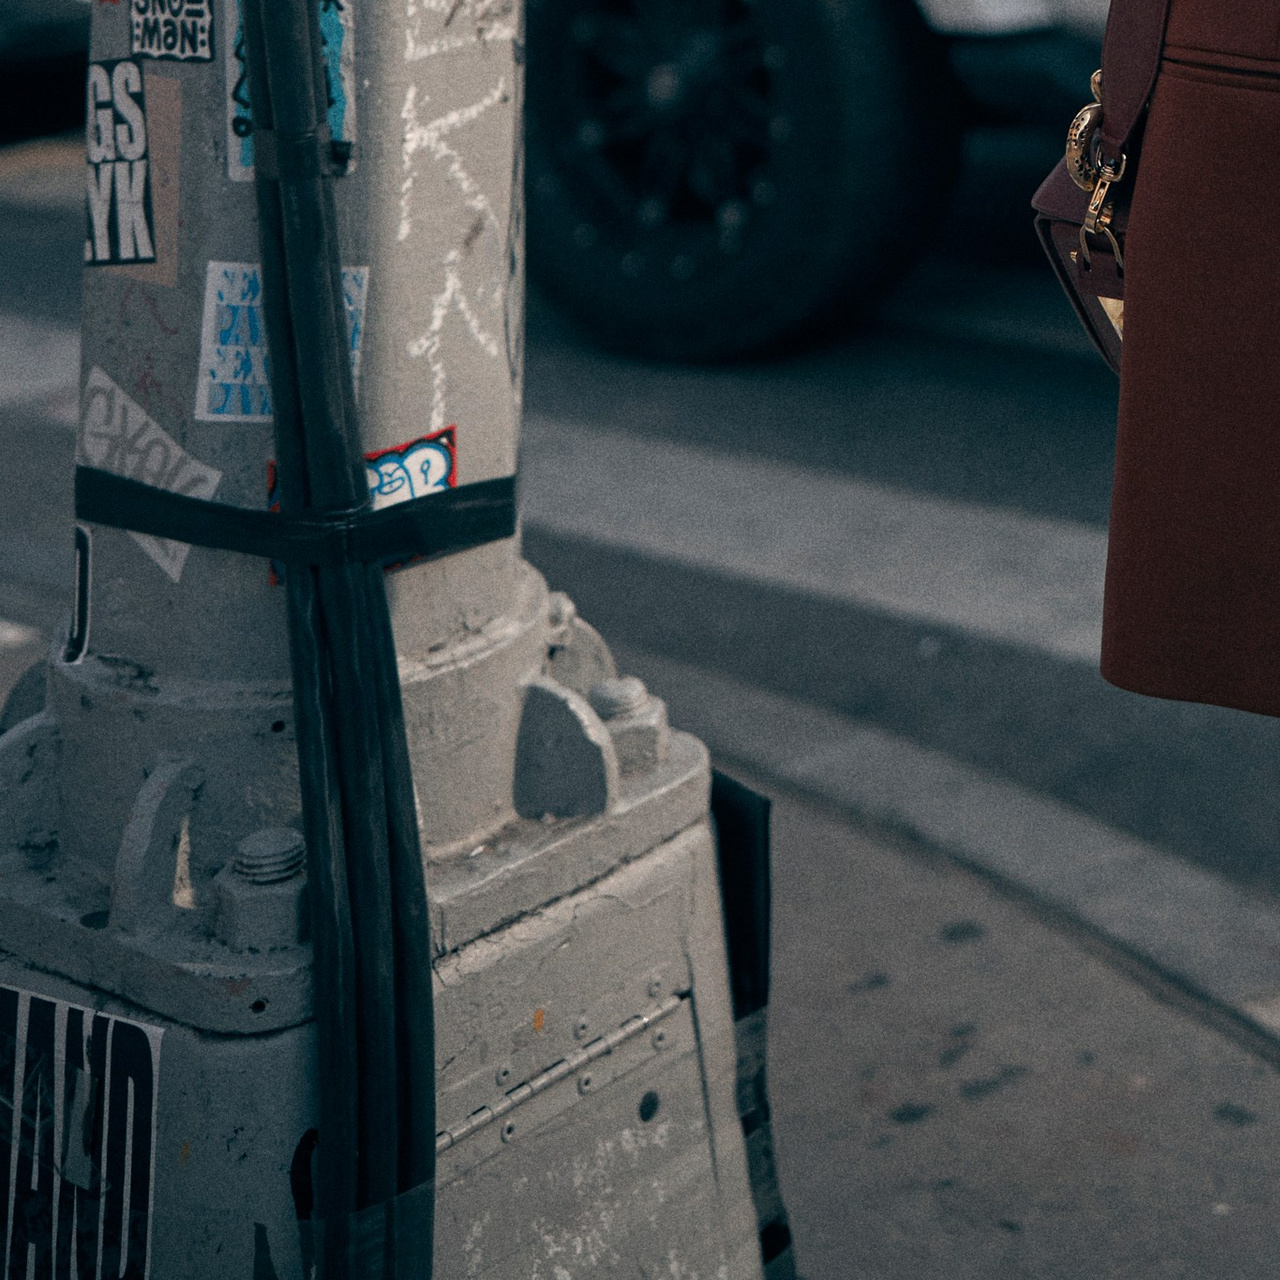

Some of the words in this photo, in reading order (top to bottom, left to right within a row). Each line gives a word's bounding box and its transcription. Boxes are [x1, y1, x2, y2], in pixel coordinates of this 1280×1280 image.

[87, 61, 146, 161] GS
[84, 160, 154, 261] YK
[0, 986, 154, 1280] AND
